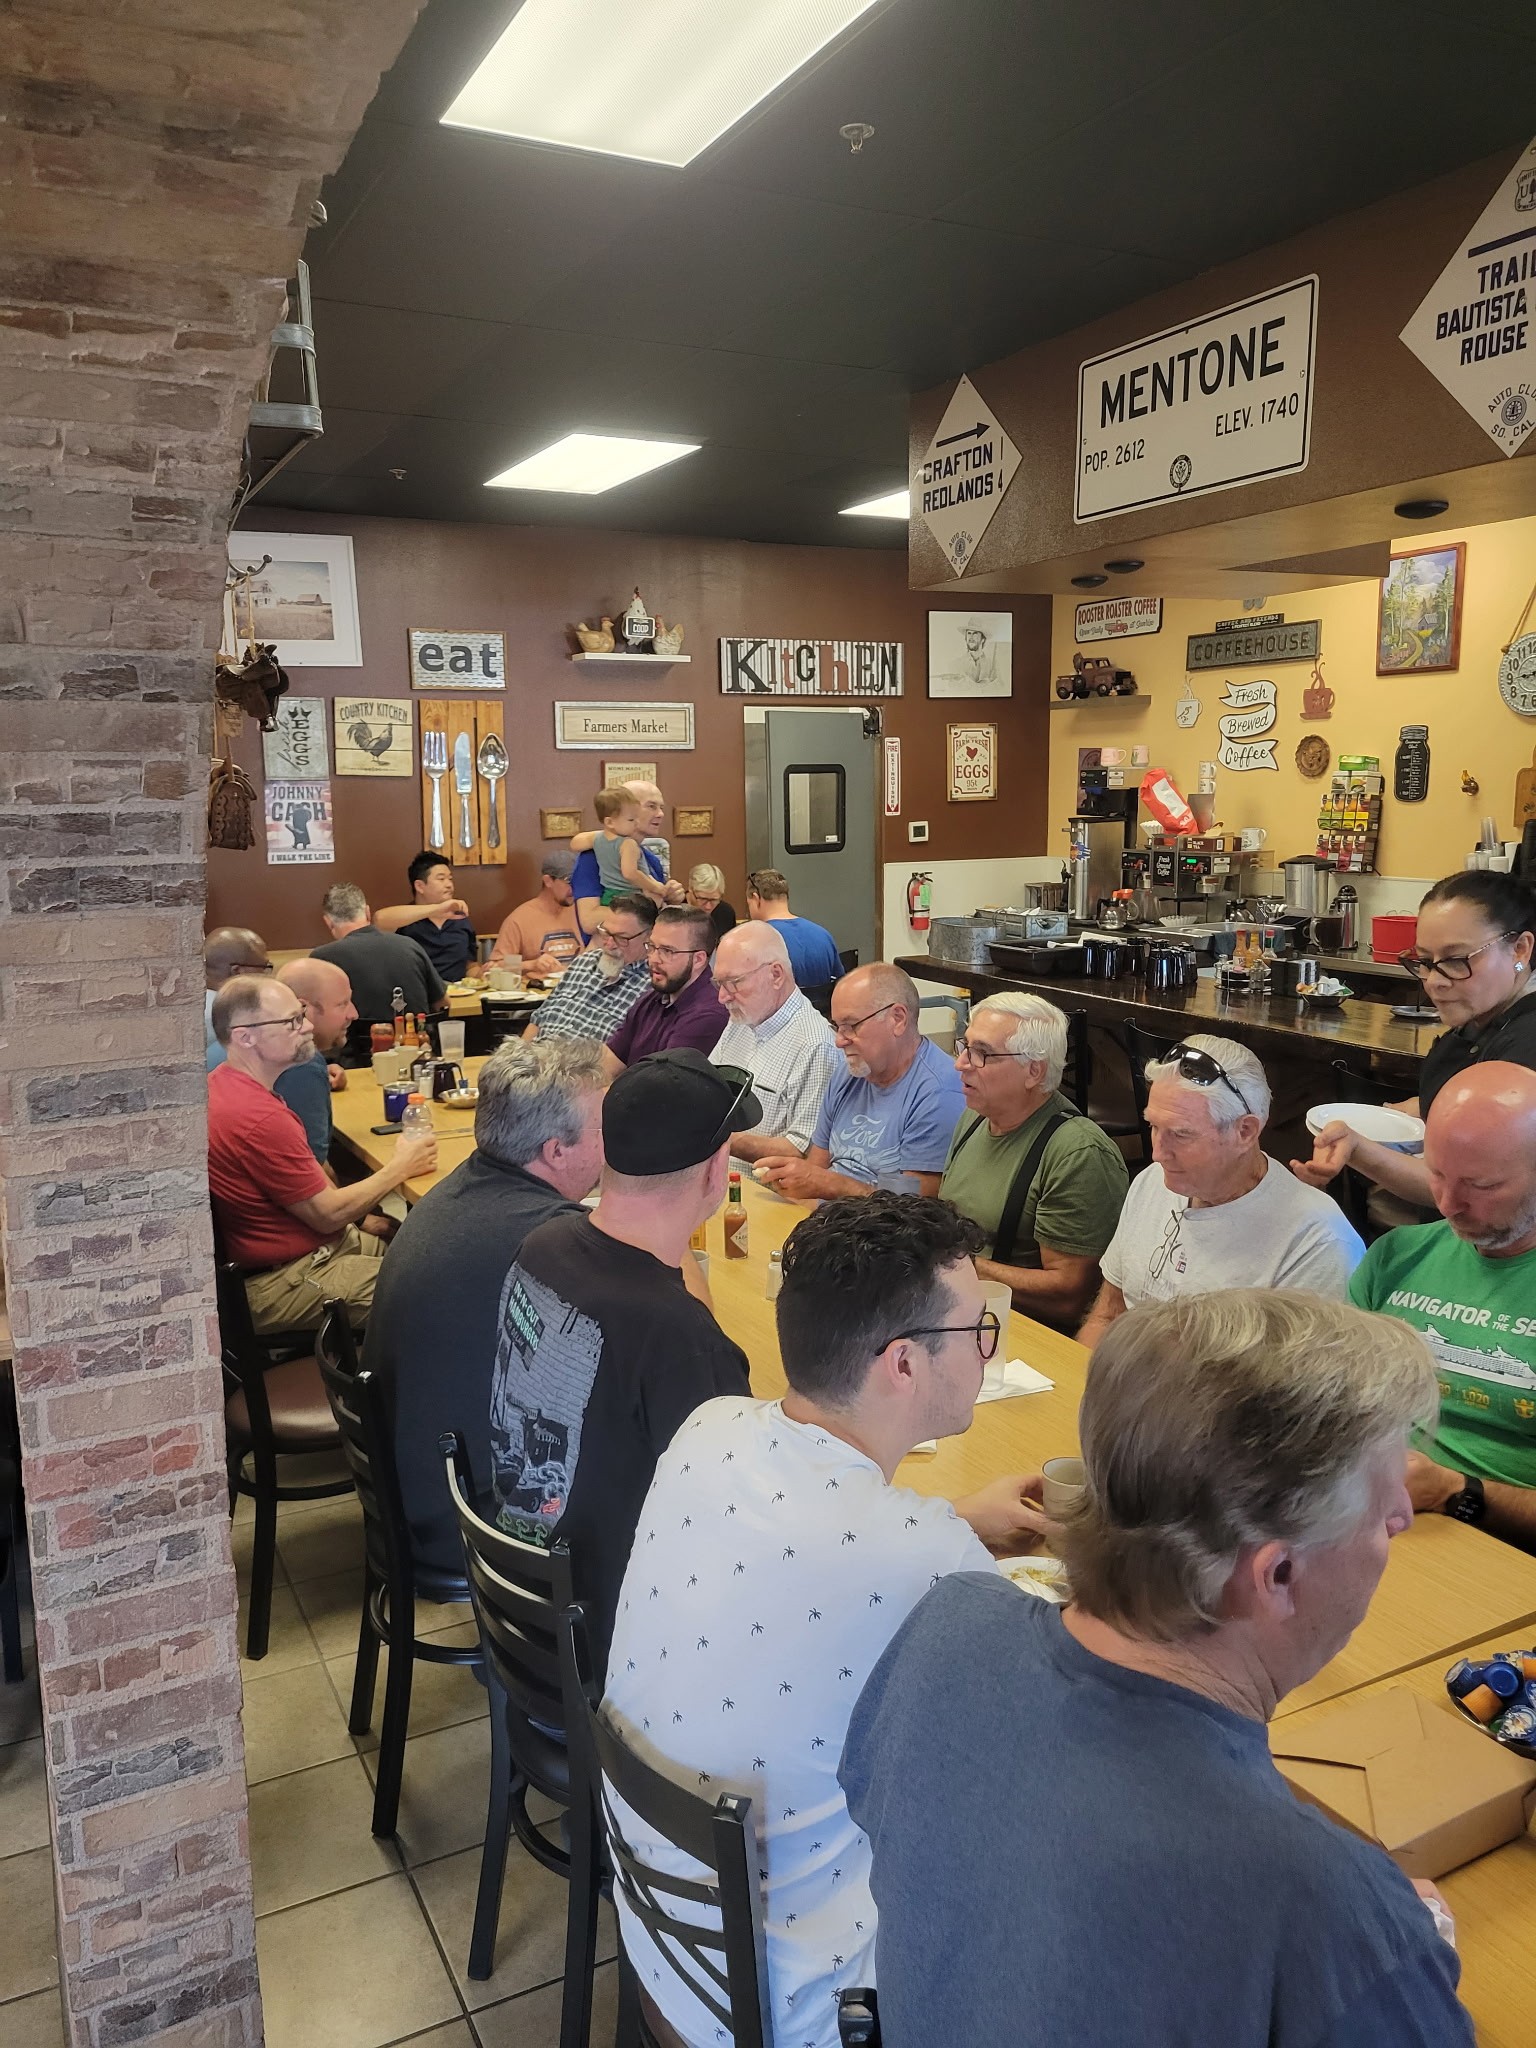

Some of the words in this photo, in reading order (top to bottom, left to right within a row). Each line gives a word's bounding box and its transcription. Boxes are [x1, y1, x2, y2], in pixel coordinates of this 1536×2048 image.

[1436, 288, 1527, 340] BAUTISTA
[1460, 321, 1529, 366] ROUSE
[1101, 316, 1286, 429] MENTONE
[1488, 387, 1512, 413] AUTO
[1215, 406, 1254, 437] ELEV.
[1261, 392, 1299, 424] 1740
[1513, 420, 1535, 437] CAL
[923, 441, 993, 485] CRAFTON
[1085, 450, 1110, 474] POP.
[1115, 438, 1145, 466] 2612
[923, 472, 994, 514] REDLANDS
[998, 468, 1003, 493] 4
[949, 532, 960, 548] AUTO
[961, 530, 973, 544] CLUB
[1077, 605, 1104, 626] ROOSTER
[1105, 600, 1132, 620] ROASTER
[1134, 598, 1157, 616] COFFEE
[1194, 631, 1309, 661] COFFEEHOUSE
[1517, 646, 1526, 659] 11
[418, 643, 497, 678] eat
[1508, 658, 1519, 671] 10
[1507, 672, 1513, 685] 9
[1235, 684, 1268, 704] Fresh
[1510, 686, 1517, 698] 8
[1521, 694, 1527, 707] 7
[340, 702, 374, 721] COUNTRY
[377, 703, 408, 723] KITCHEN
[1227, 711, 1269, 734] Brewed
[584, 719, 627, 733] Farmers
[631, 719, 668, 733] Market
[291, 719, 312, 766] EGGS
[1225, 746, 1268, 768] Coffee
[956, 764, 989, 779] EGGS
[272, 786, 323, 800] JOHNNY
[271, 802, 327, 821] CASH
[314, 853, 331, 861] LINE
[839, 1113, 887, 1149] Ford
[513, 1280, 540, 1328] IN-N-OUT
[1386, 1289, 1492, 1328] NAVIGATOR
[1497, 1313, 1512, 1323] OF
[508, 1294, 540, 1351] HAMBURGERS
[1492, 1321, 1510, 1332] THE
